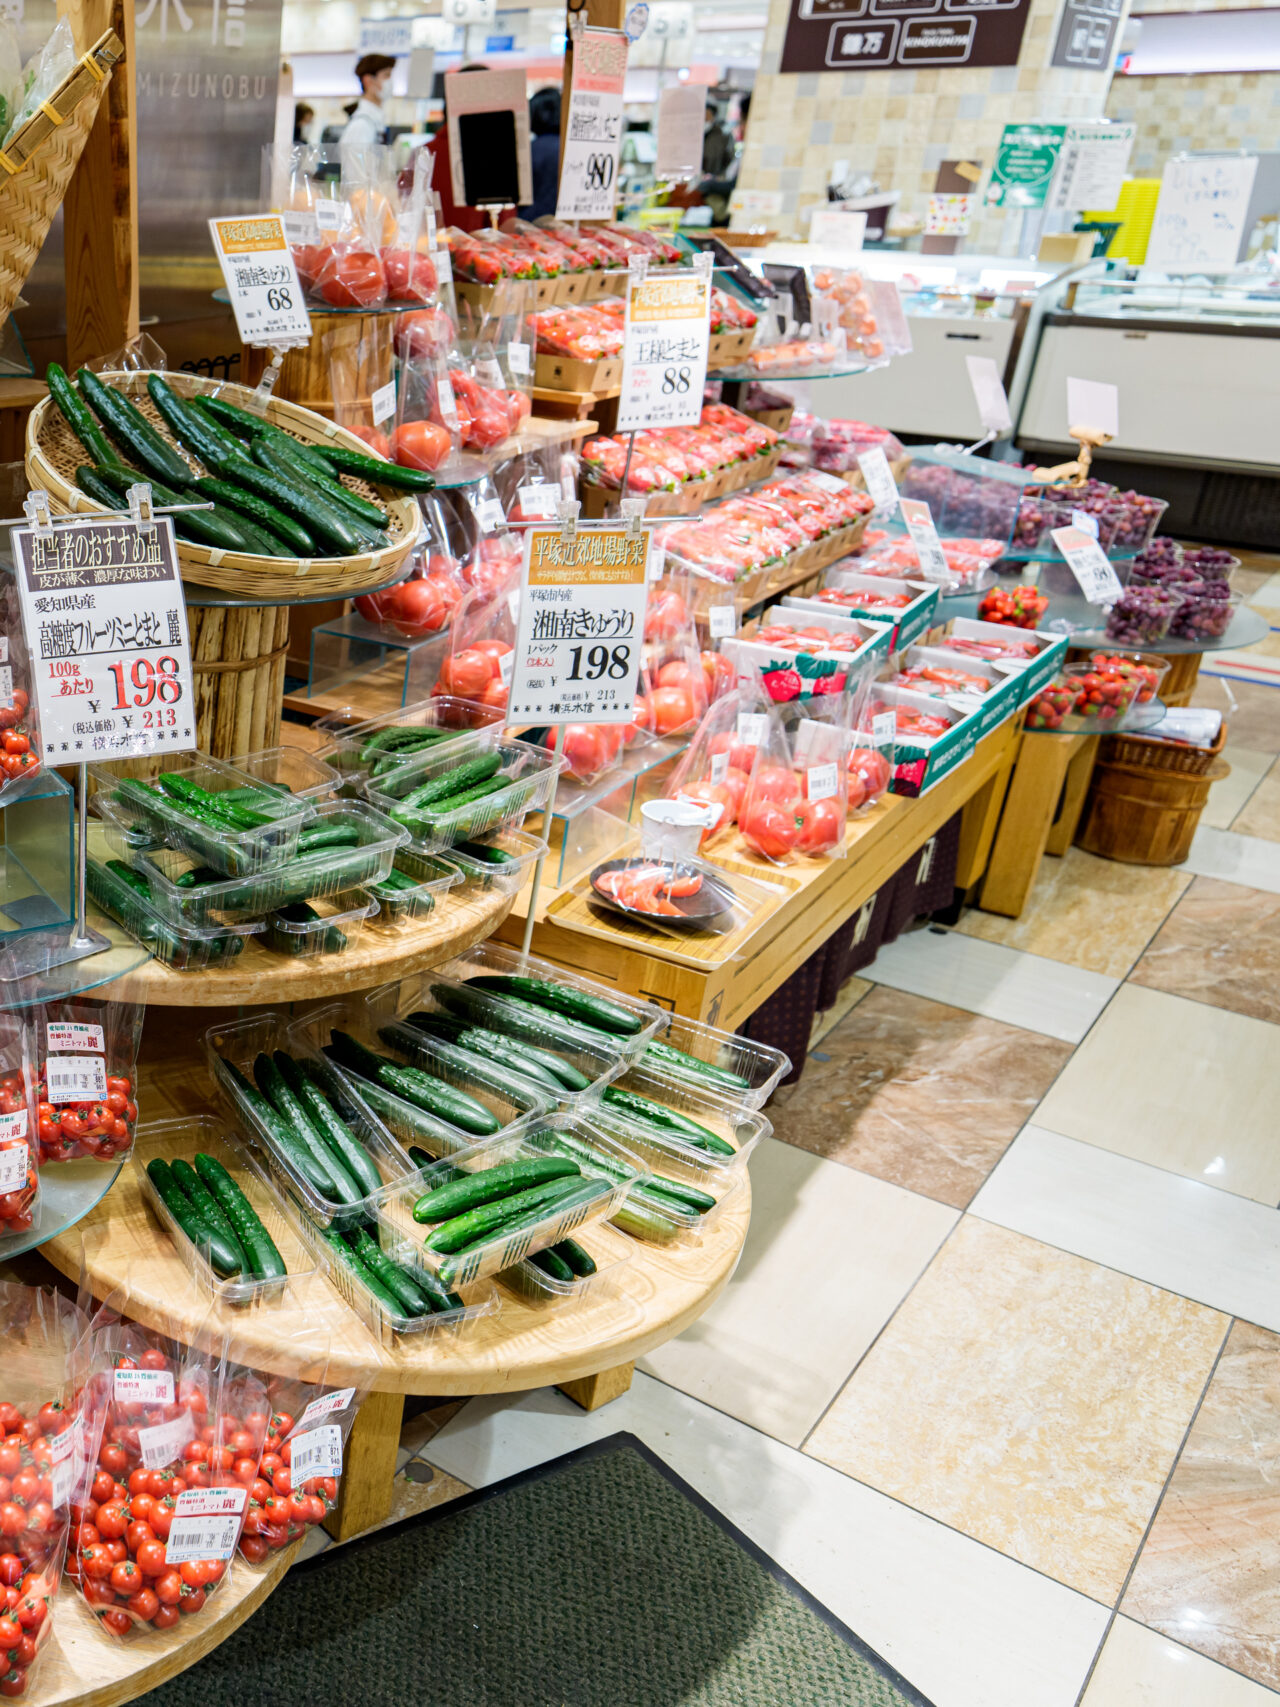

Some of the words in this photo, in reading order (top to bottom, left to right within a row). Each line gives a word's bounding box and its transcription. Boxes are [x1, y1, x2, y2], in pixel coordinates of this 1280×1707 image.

[136, 72, 267, 99] MIZUNOBU
[585, 153, 614, 190] 980
[267, 287, 293, 311] 68
[661, 366, 692, 395] 88
[32, 525, 164, 572] 担当者のおすすめ品
[34, 594, 96, 614] 愛知県産
[532, 608, 635, 638] 湘南きゅうり
[48, 661, 81, 678] 100g
[565, 645, 631, 681] 198
[60, 677, 94, 695] あたり
[108, 655, 183, 710] 198
[597, 690, 616, 700] 213
[142, 708, 177, 728] 213
